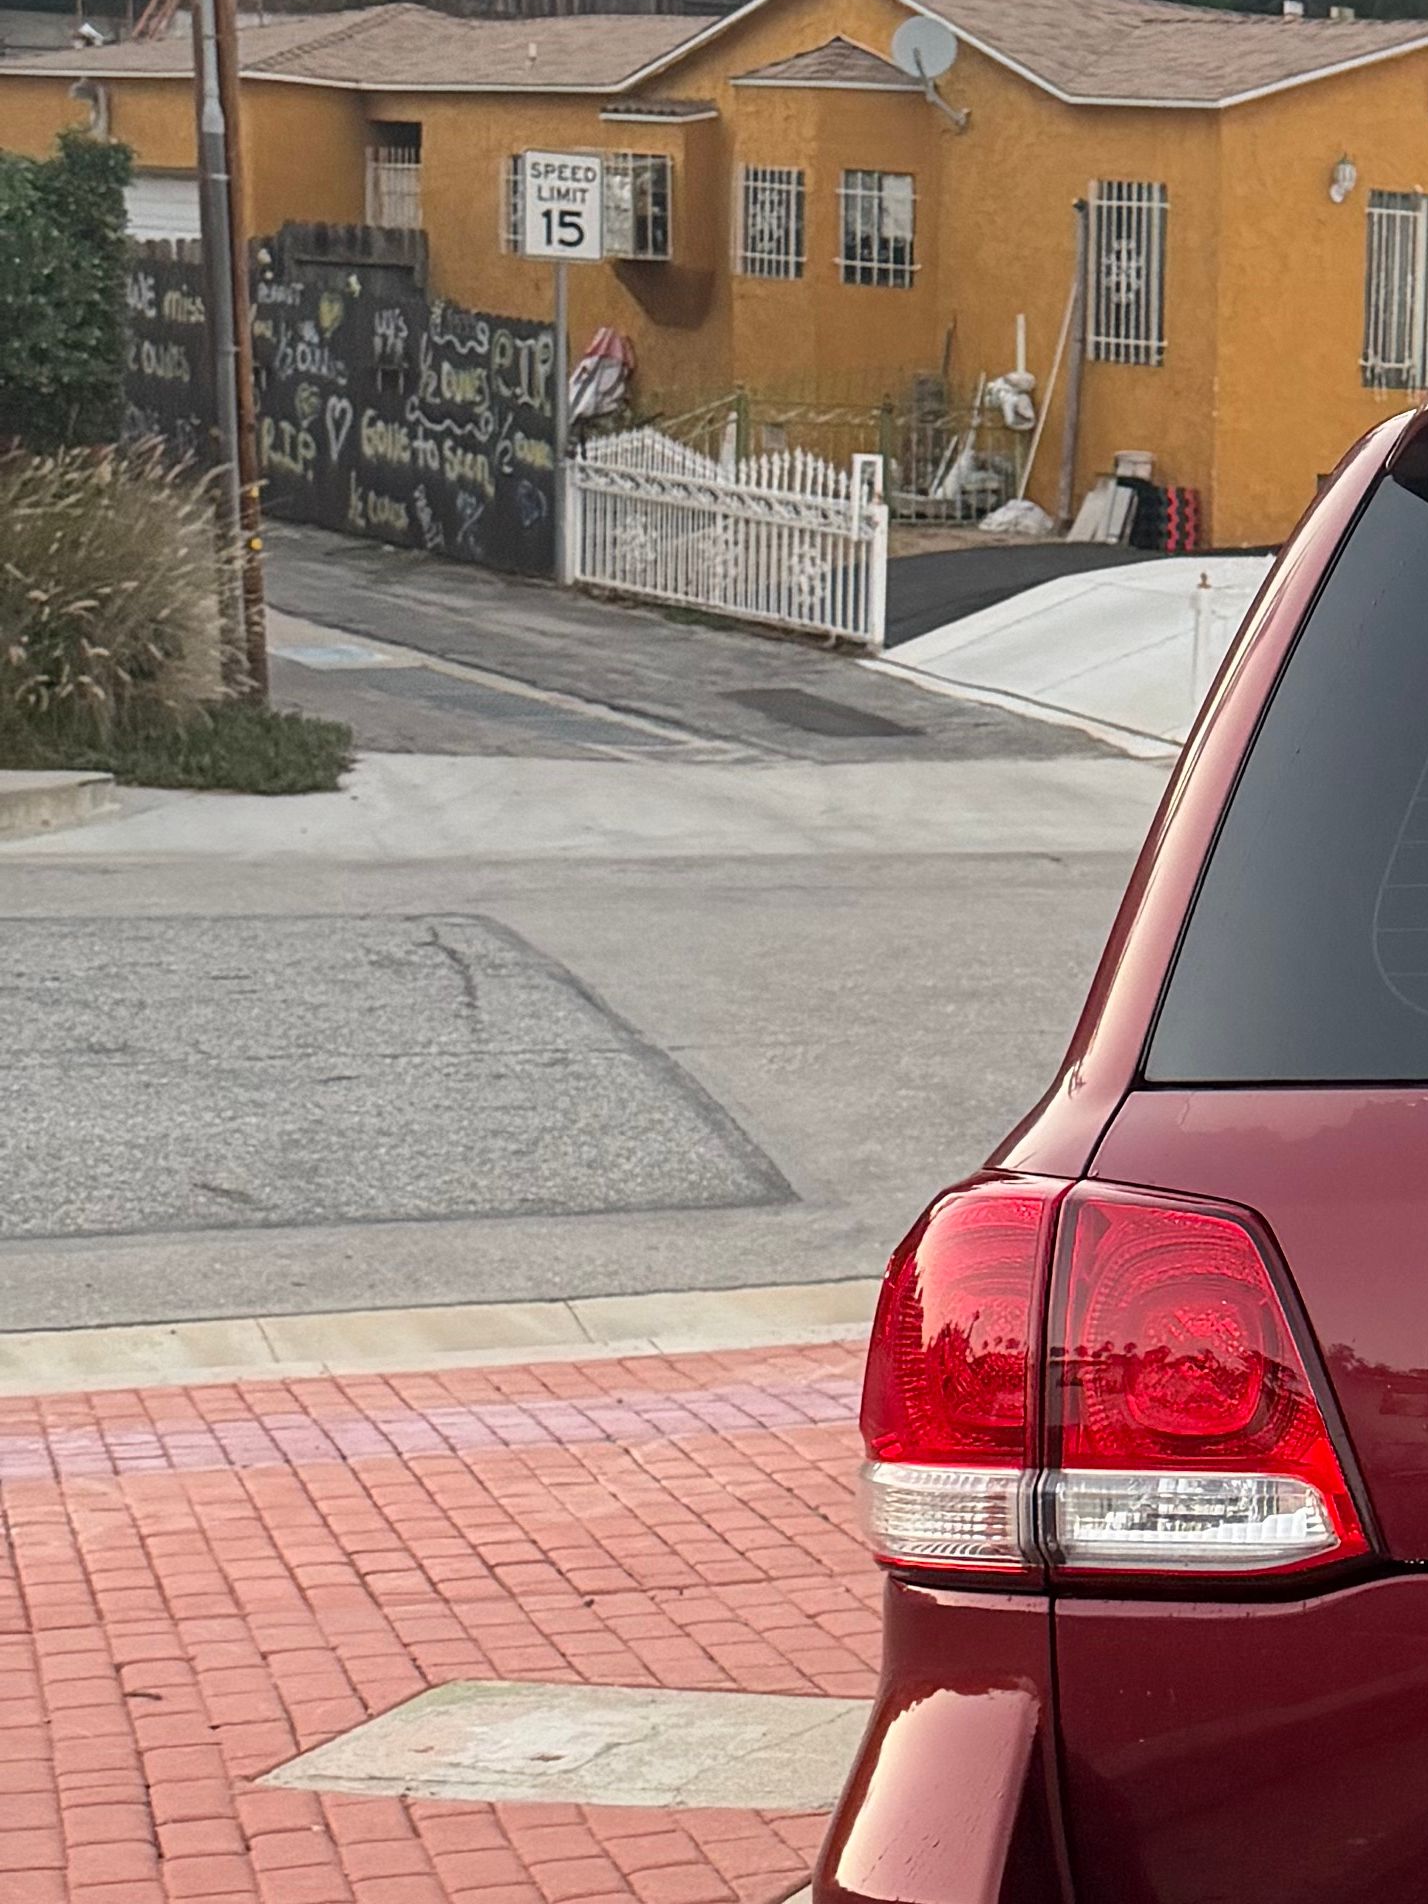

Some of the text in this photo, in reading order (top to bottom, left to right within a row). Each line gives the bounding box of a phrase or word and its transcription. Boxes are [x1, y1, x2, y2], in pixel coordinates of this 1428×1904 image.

[530, 162, 597, 183] SPEED
[538, 184, 589, 204] LIMIT
[542, 208, 584, 247] 15
